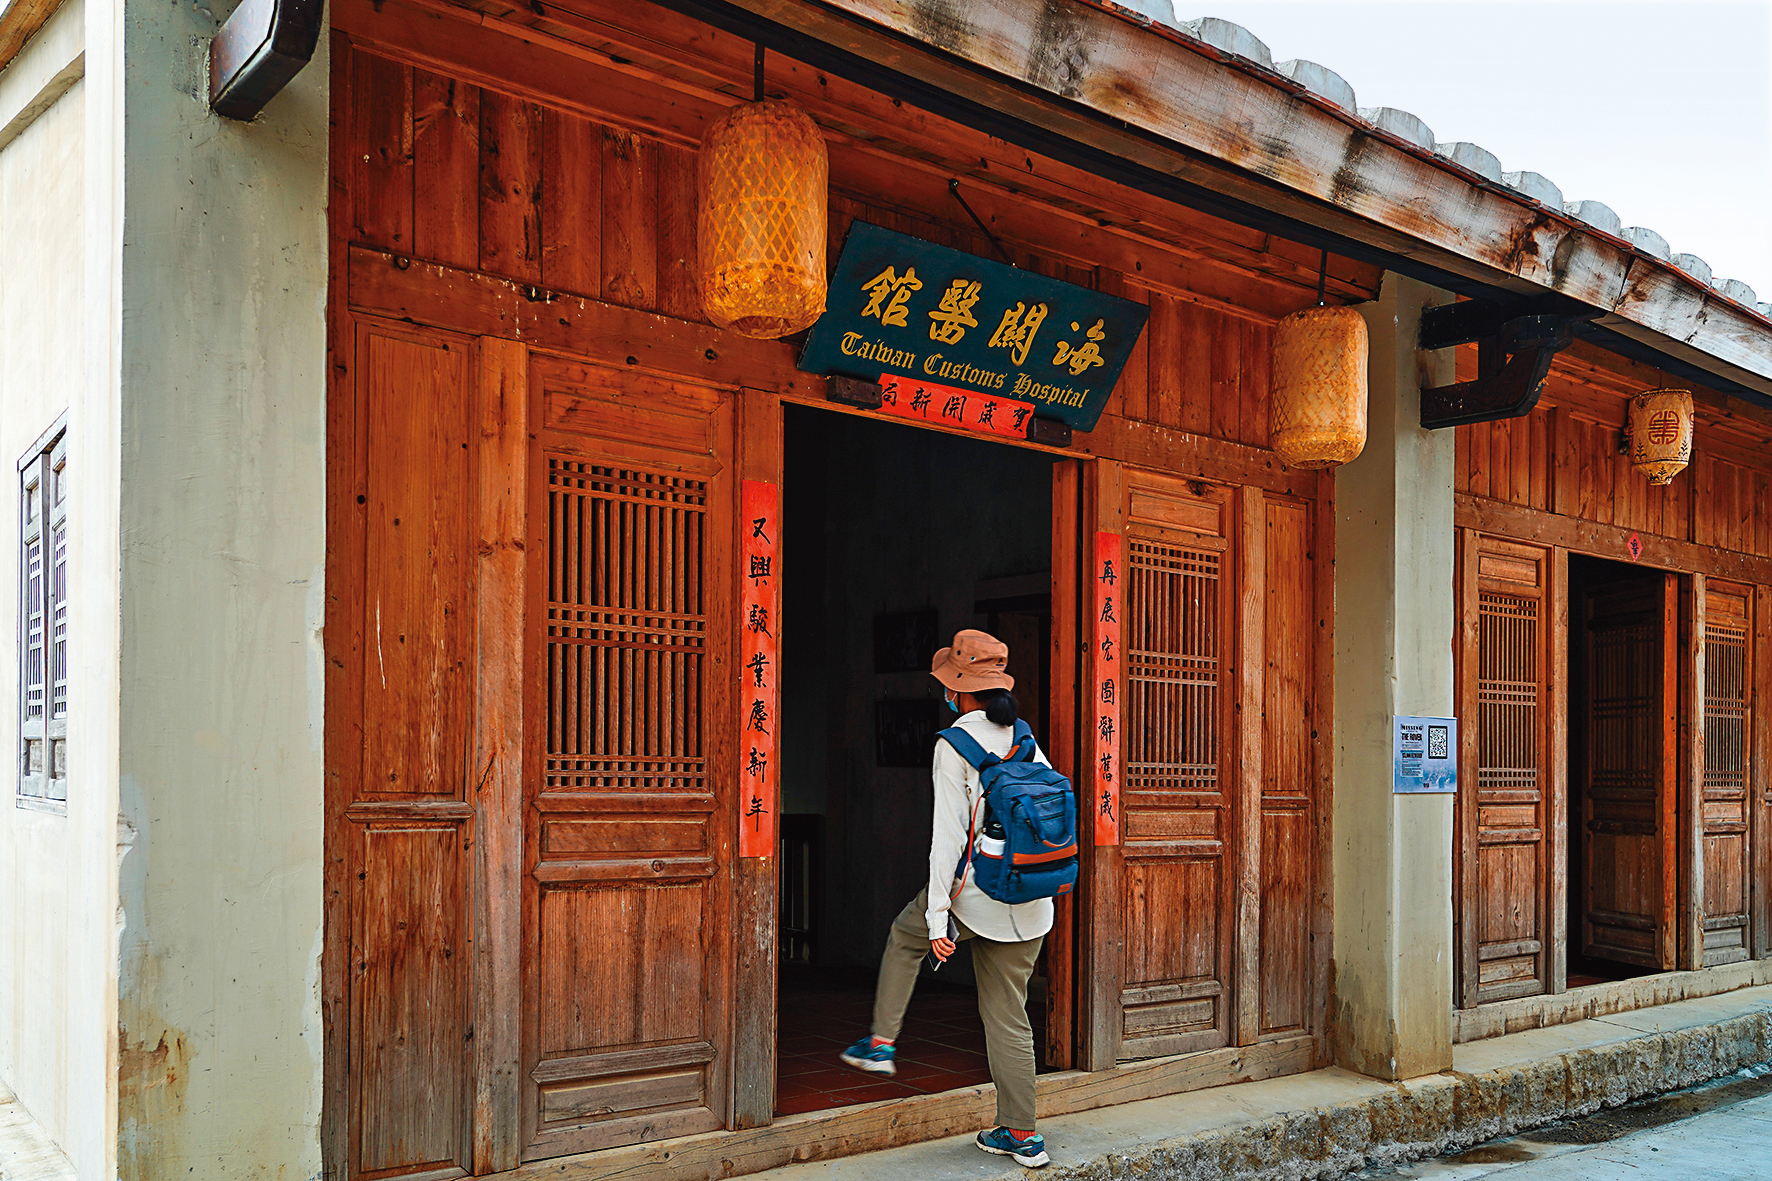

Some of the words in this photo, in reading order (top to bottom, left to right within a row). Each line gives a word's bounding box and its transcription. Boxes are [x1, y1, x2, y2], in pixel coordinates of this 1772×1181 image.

[840, 331, 917, 369] Taiwan
[923, 353, 1008, 389] Customs
[1010, 372, 1089, 408] Hospital
